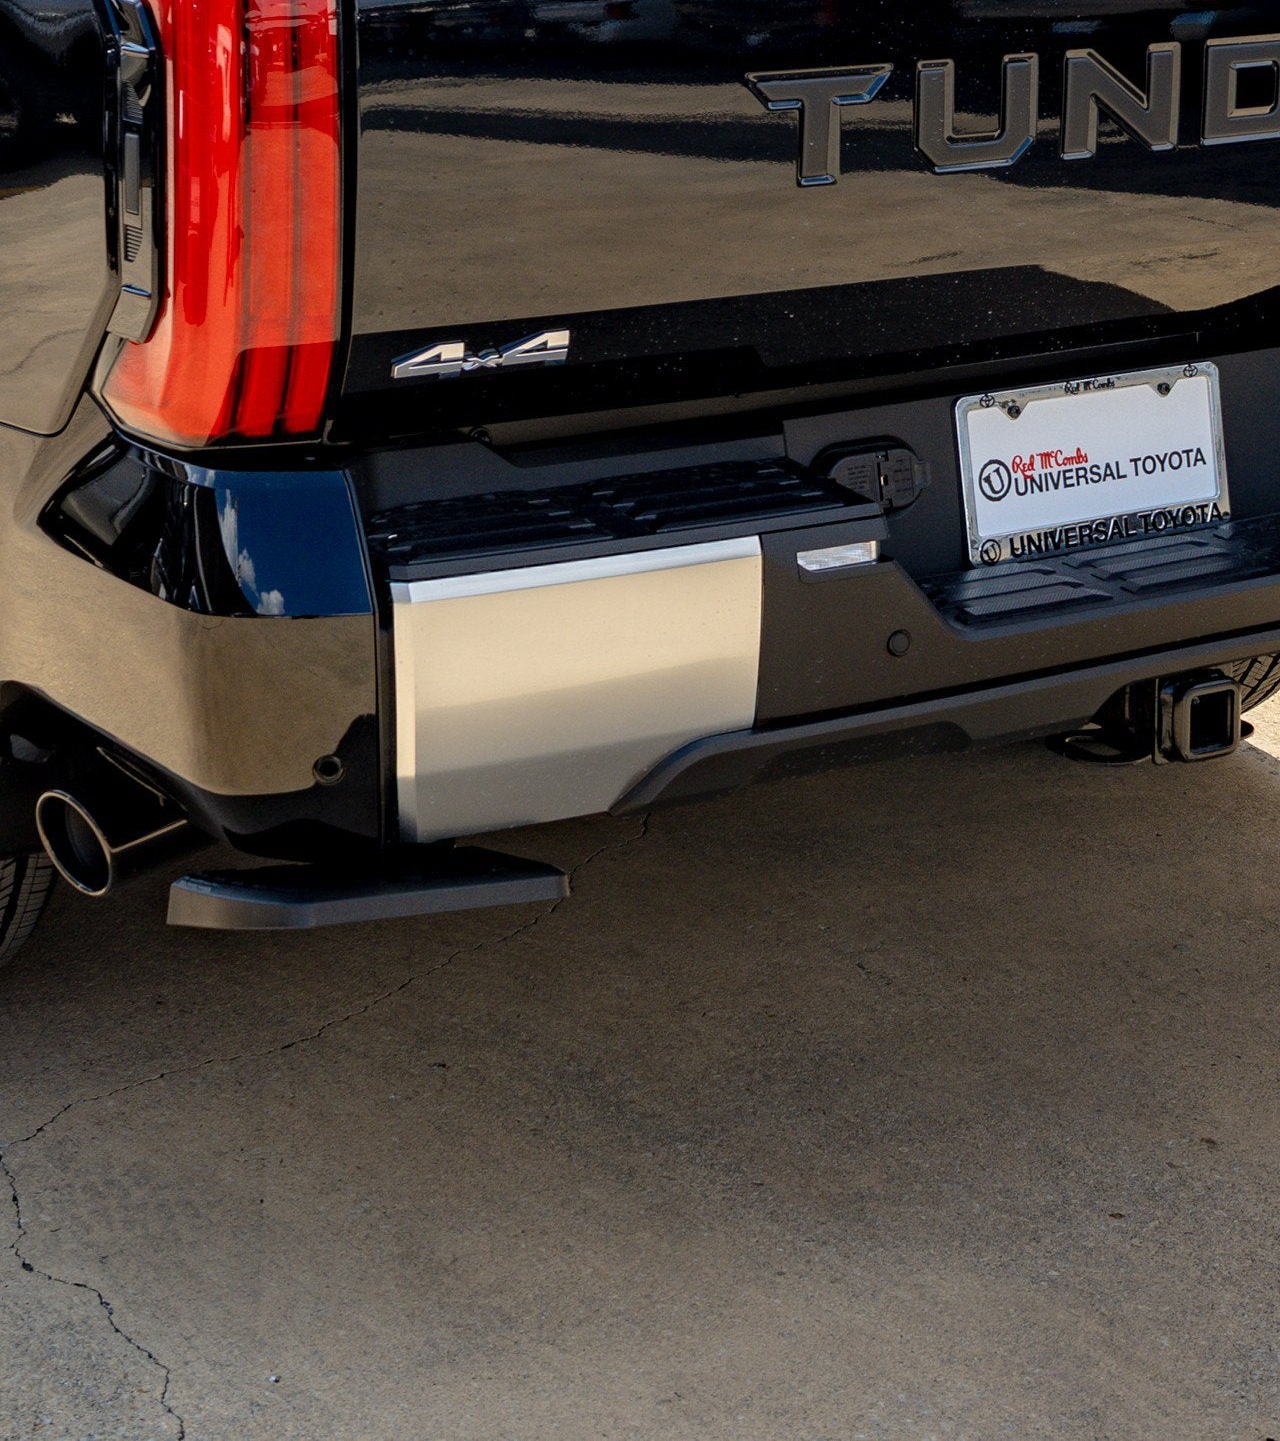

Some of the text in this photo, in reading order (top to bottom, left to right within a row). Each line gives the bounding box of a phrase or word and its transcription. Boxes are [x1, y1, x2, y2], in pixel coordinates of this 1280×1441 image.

[1011, 454, 1036, 479] Red
[1014, 447, 1207, 497] UNIVERSAL TOYOTA
[1009, 503, 1223, 559] UNIVERSAL TOYOTA
